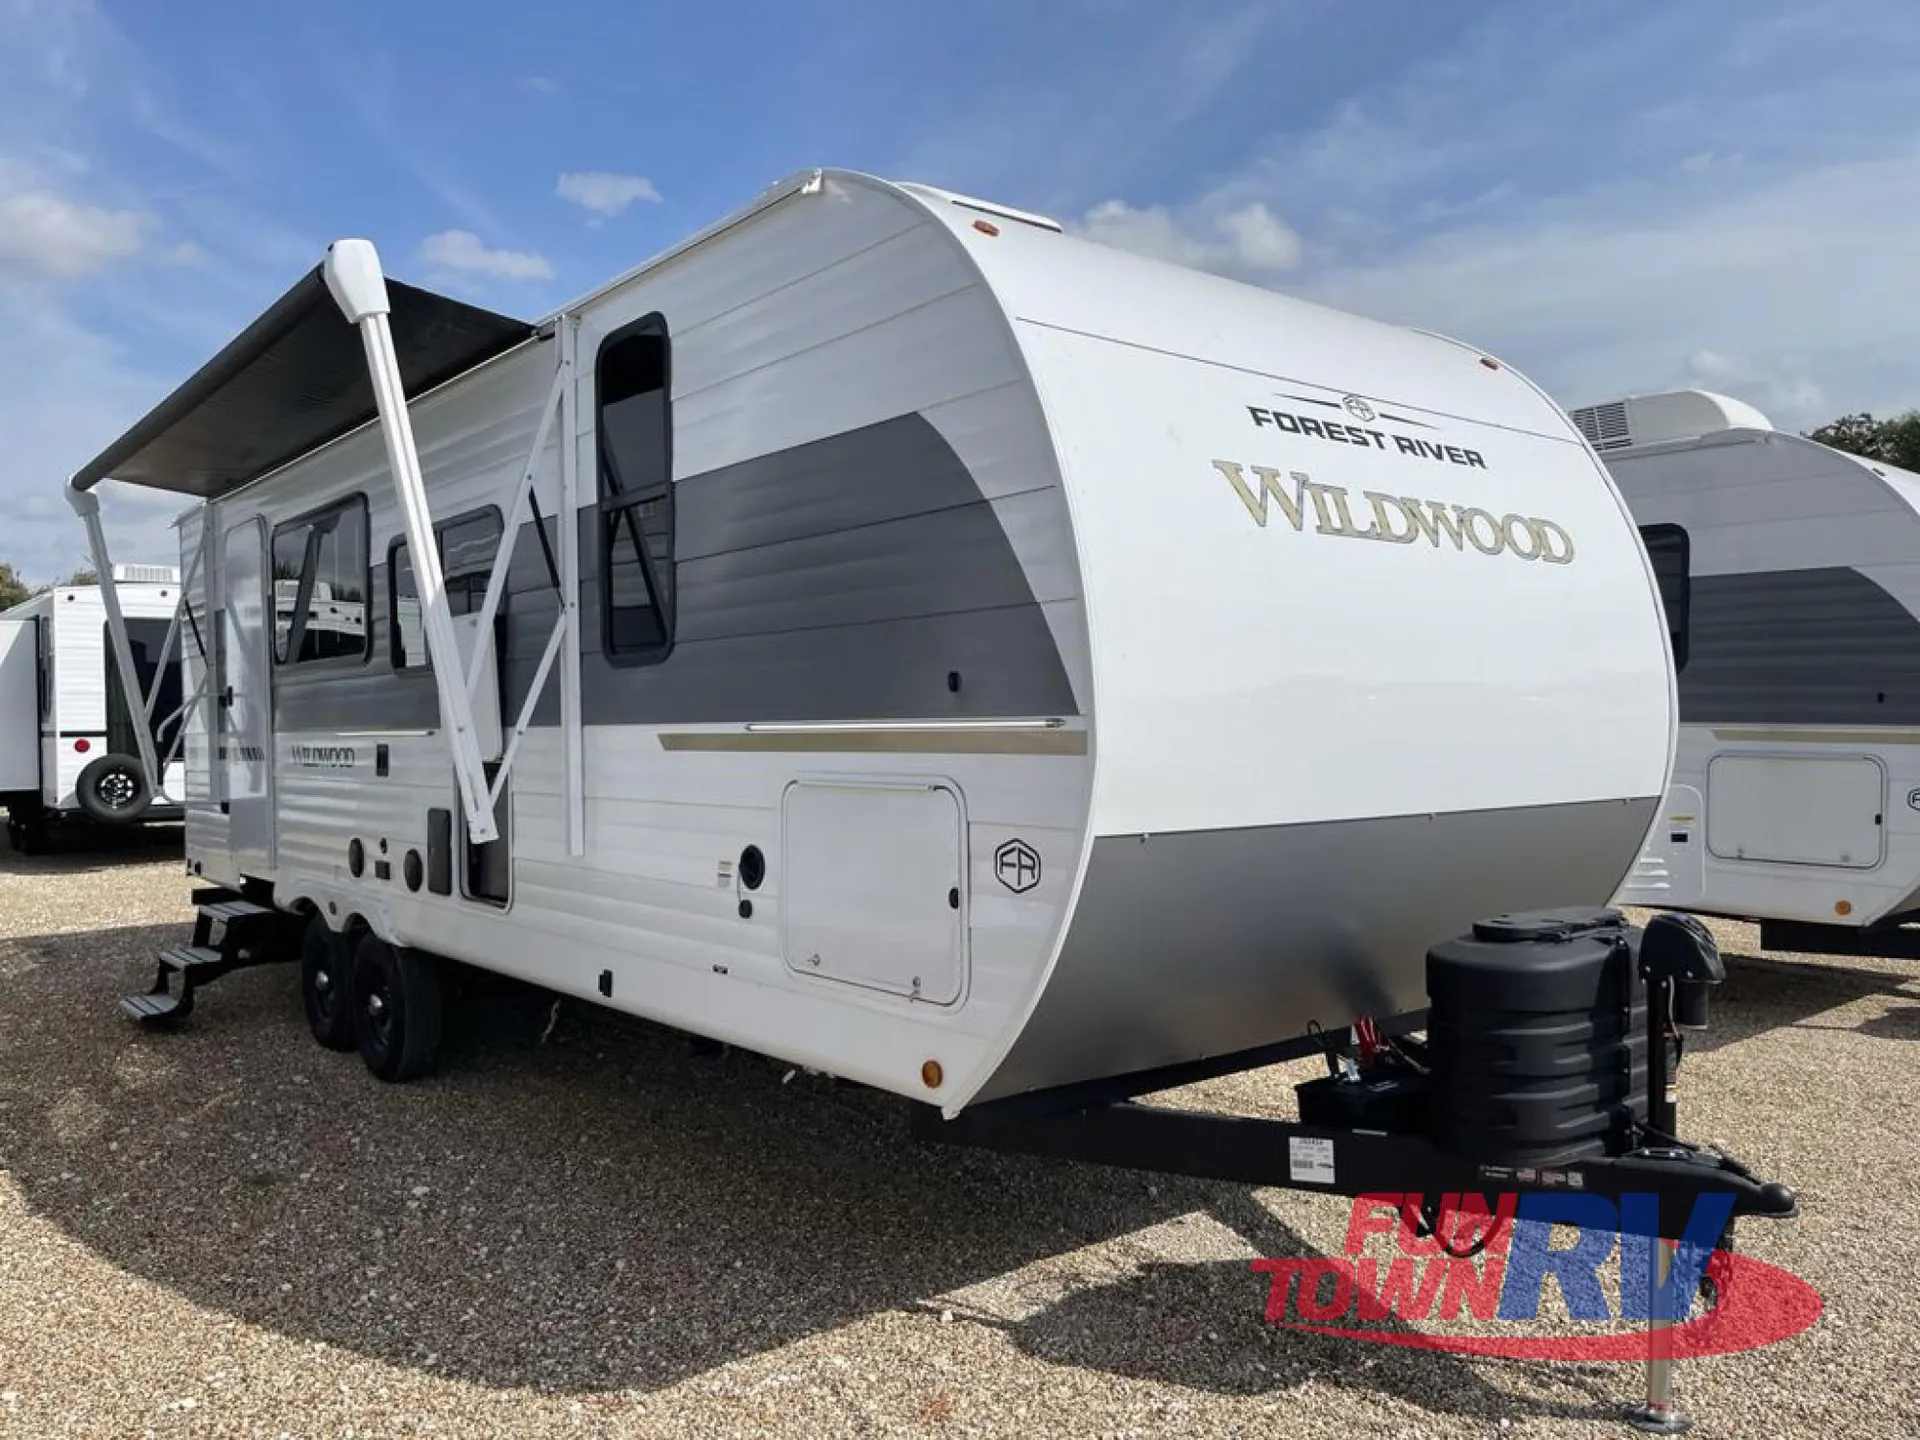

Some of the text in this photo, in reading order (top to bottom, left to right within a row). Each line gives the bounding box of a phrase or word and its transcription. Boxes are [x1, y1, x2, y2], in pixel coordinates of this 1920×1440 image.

[1245, 405, 1488, 469] FOREST RIVER
[1211, 459, 1575, 565] WILDWOOD
